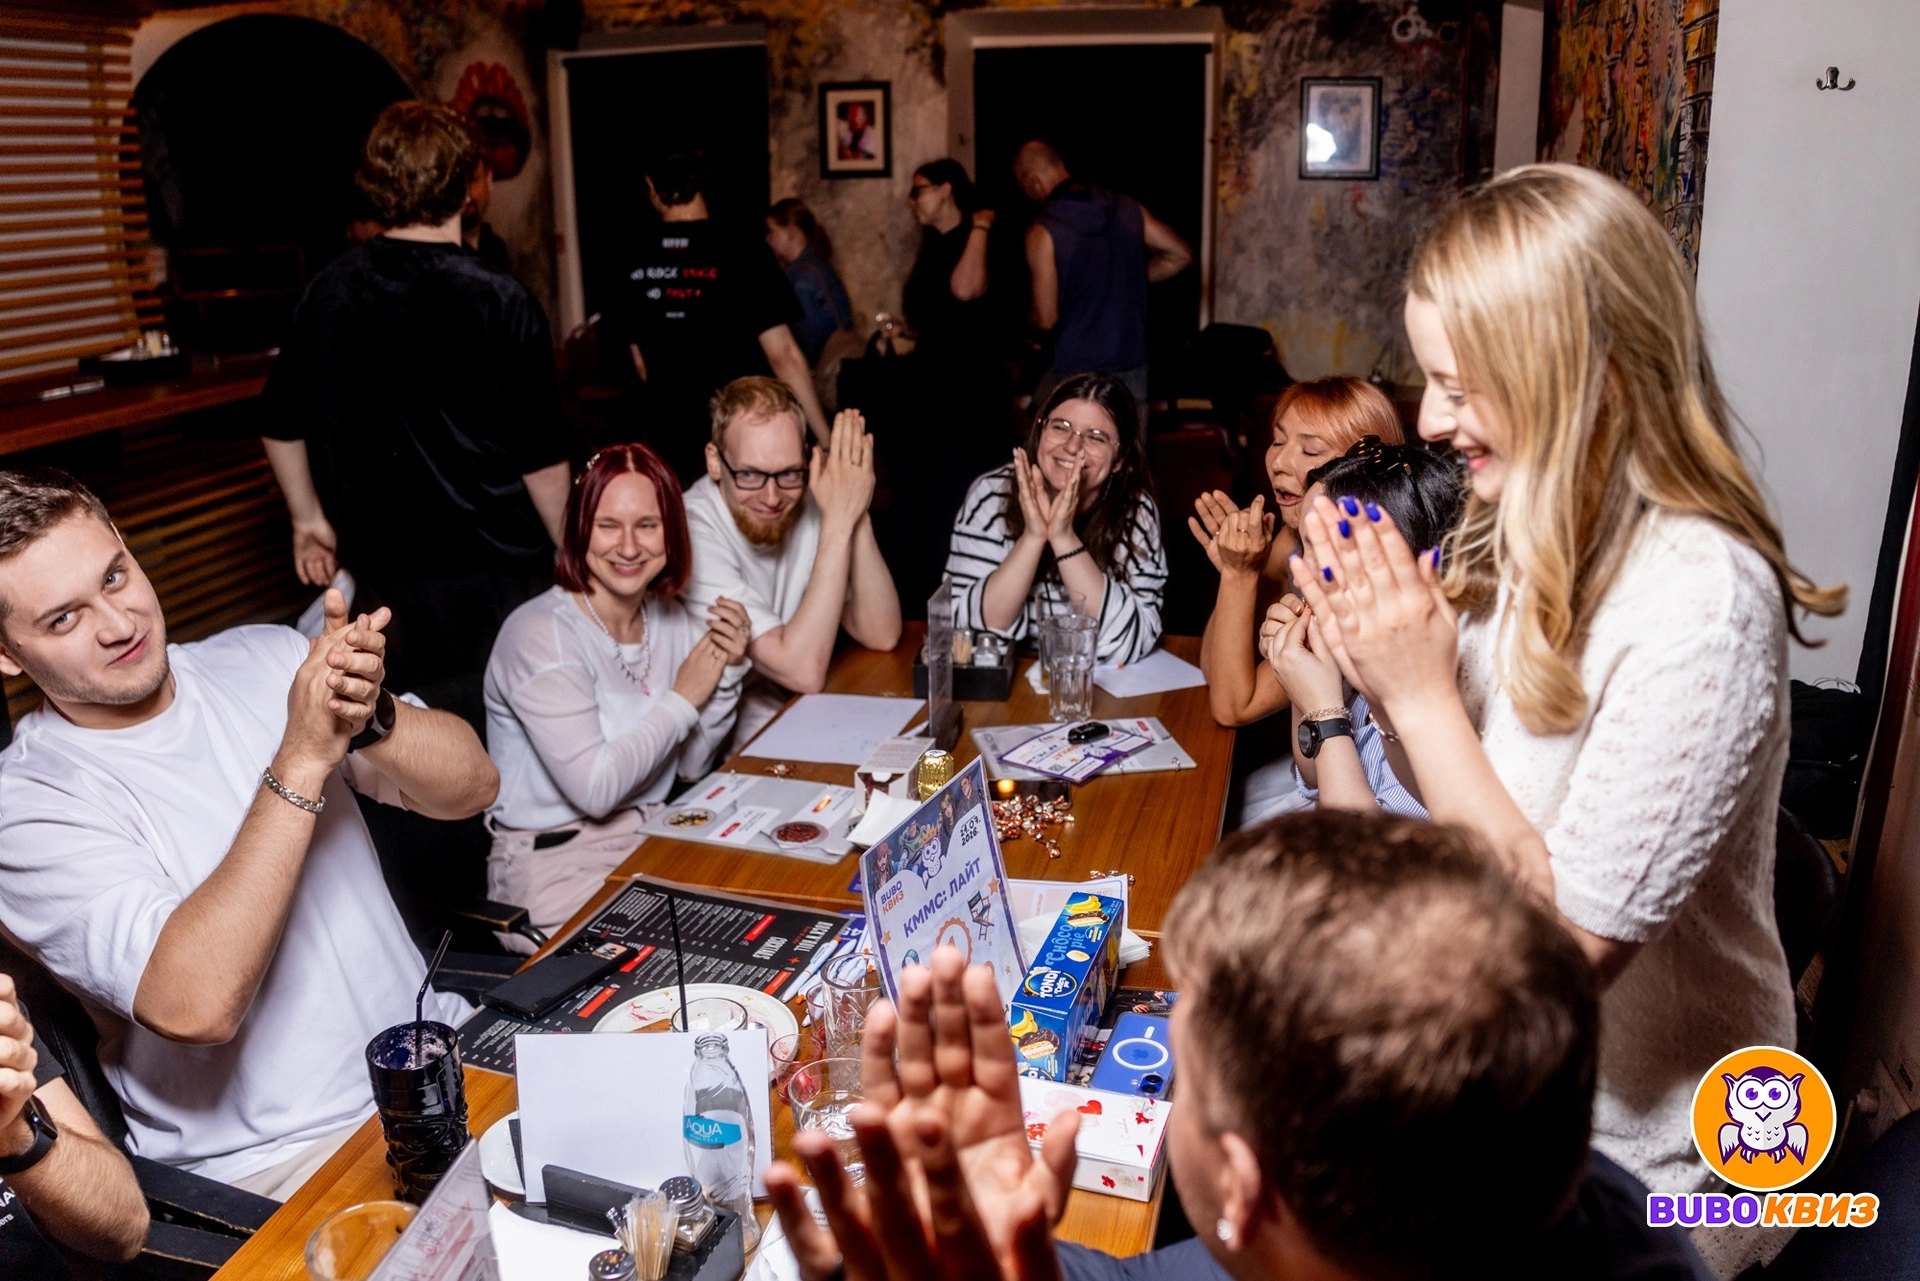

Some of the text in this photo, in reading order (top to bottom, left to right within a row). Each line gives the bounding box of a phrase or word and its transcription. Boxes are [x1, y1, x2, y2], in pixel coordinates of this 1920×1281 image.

[880, 880, 903, 905] BUBO
[881, 890, 905, 915] КВИЗ
[903, 856, 981, 938] КММС: ЛАЙТ
[1040, 970, 1062, 998] TONDI
[686, 1118, 723, 1136] AQUA
